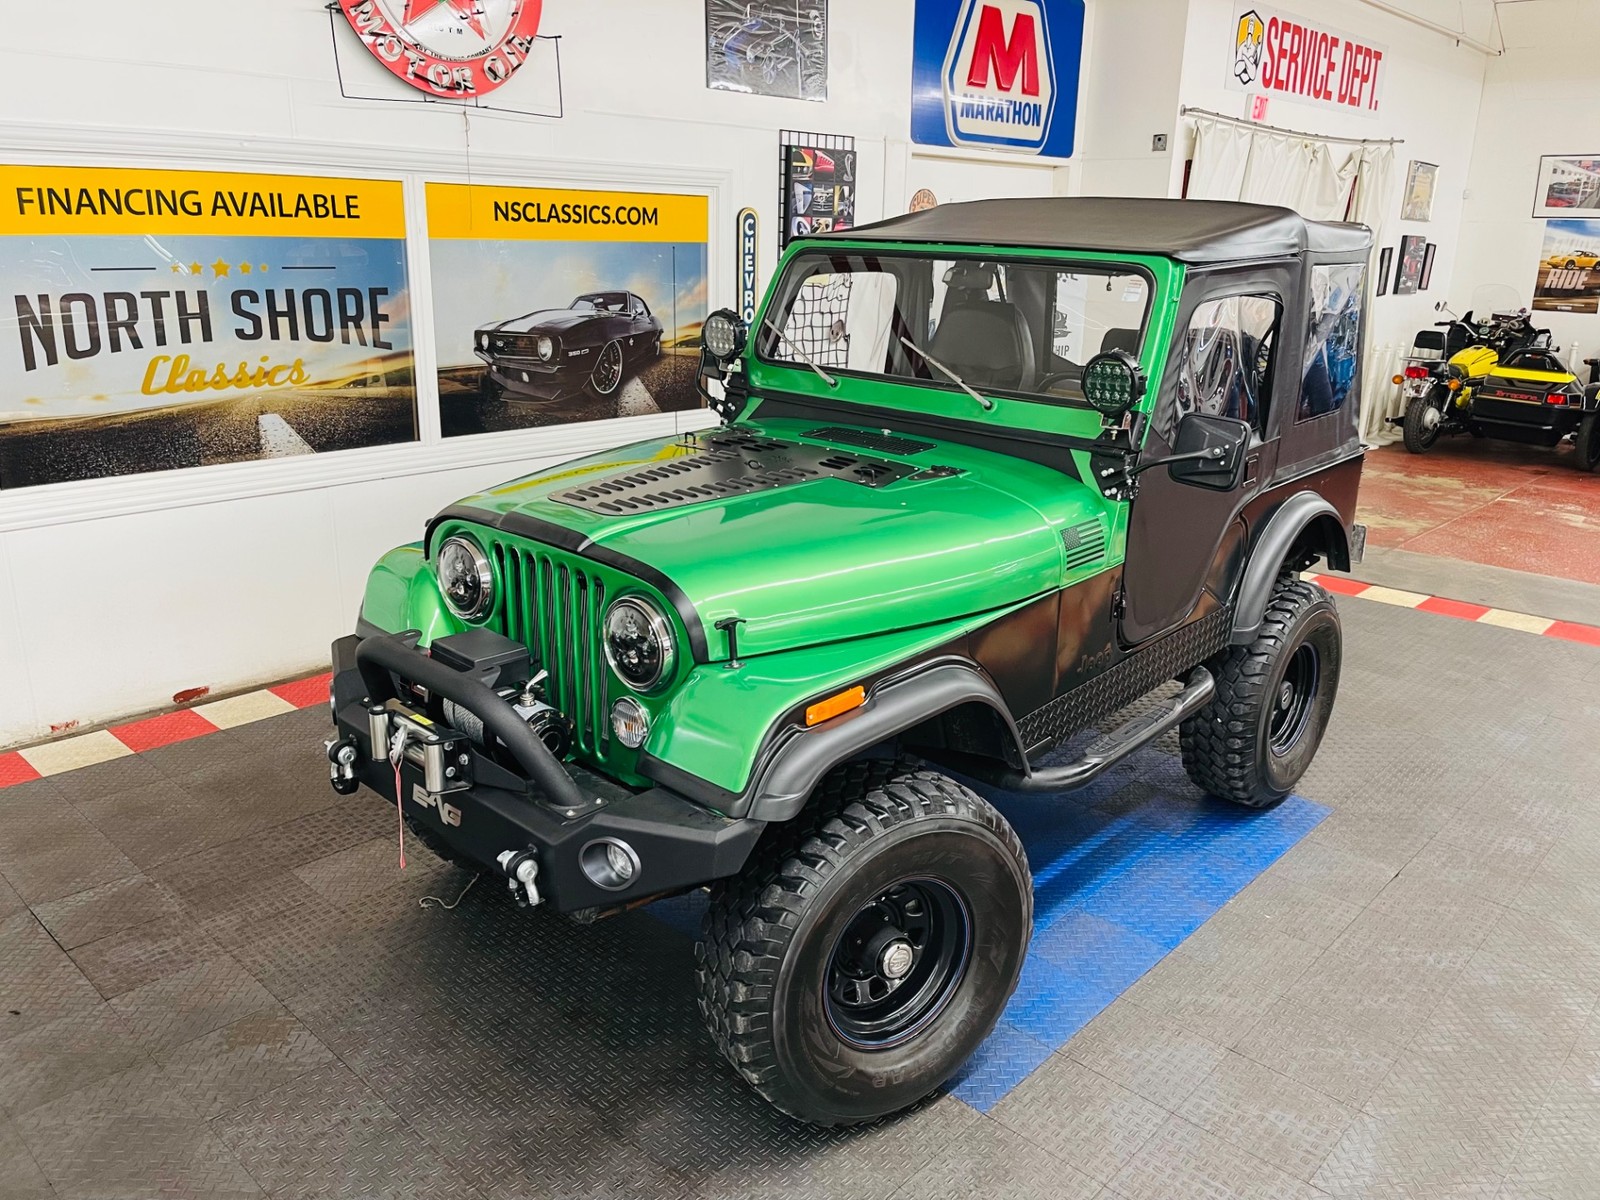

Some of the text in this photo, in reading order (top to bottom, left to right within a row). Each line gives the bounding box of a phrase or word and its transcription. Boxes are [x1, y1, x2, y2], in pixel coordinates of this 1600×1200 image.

[349, 0, 535, 94] MOTOR OIL
[966, 5, 1040, 97] M
[1262, 16, 1383, 111] SERVICE DEPT.
[960, 93, 1042, 127] MARATHON
[1252, 95, 1269, 120] EXIT
[16, 187, 361, 219] FINANCING AVAILABLE
[494, 201, 658, 226] NSCLASSICS.COM
[1544, 269, 1591, 291] RIDE
[14, 287, 393, 372] NORTH SHORE
[141, 353, 311, 396] Classics
